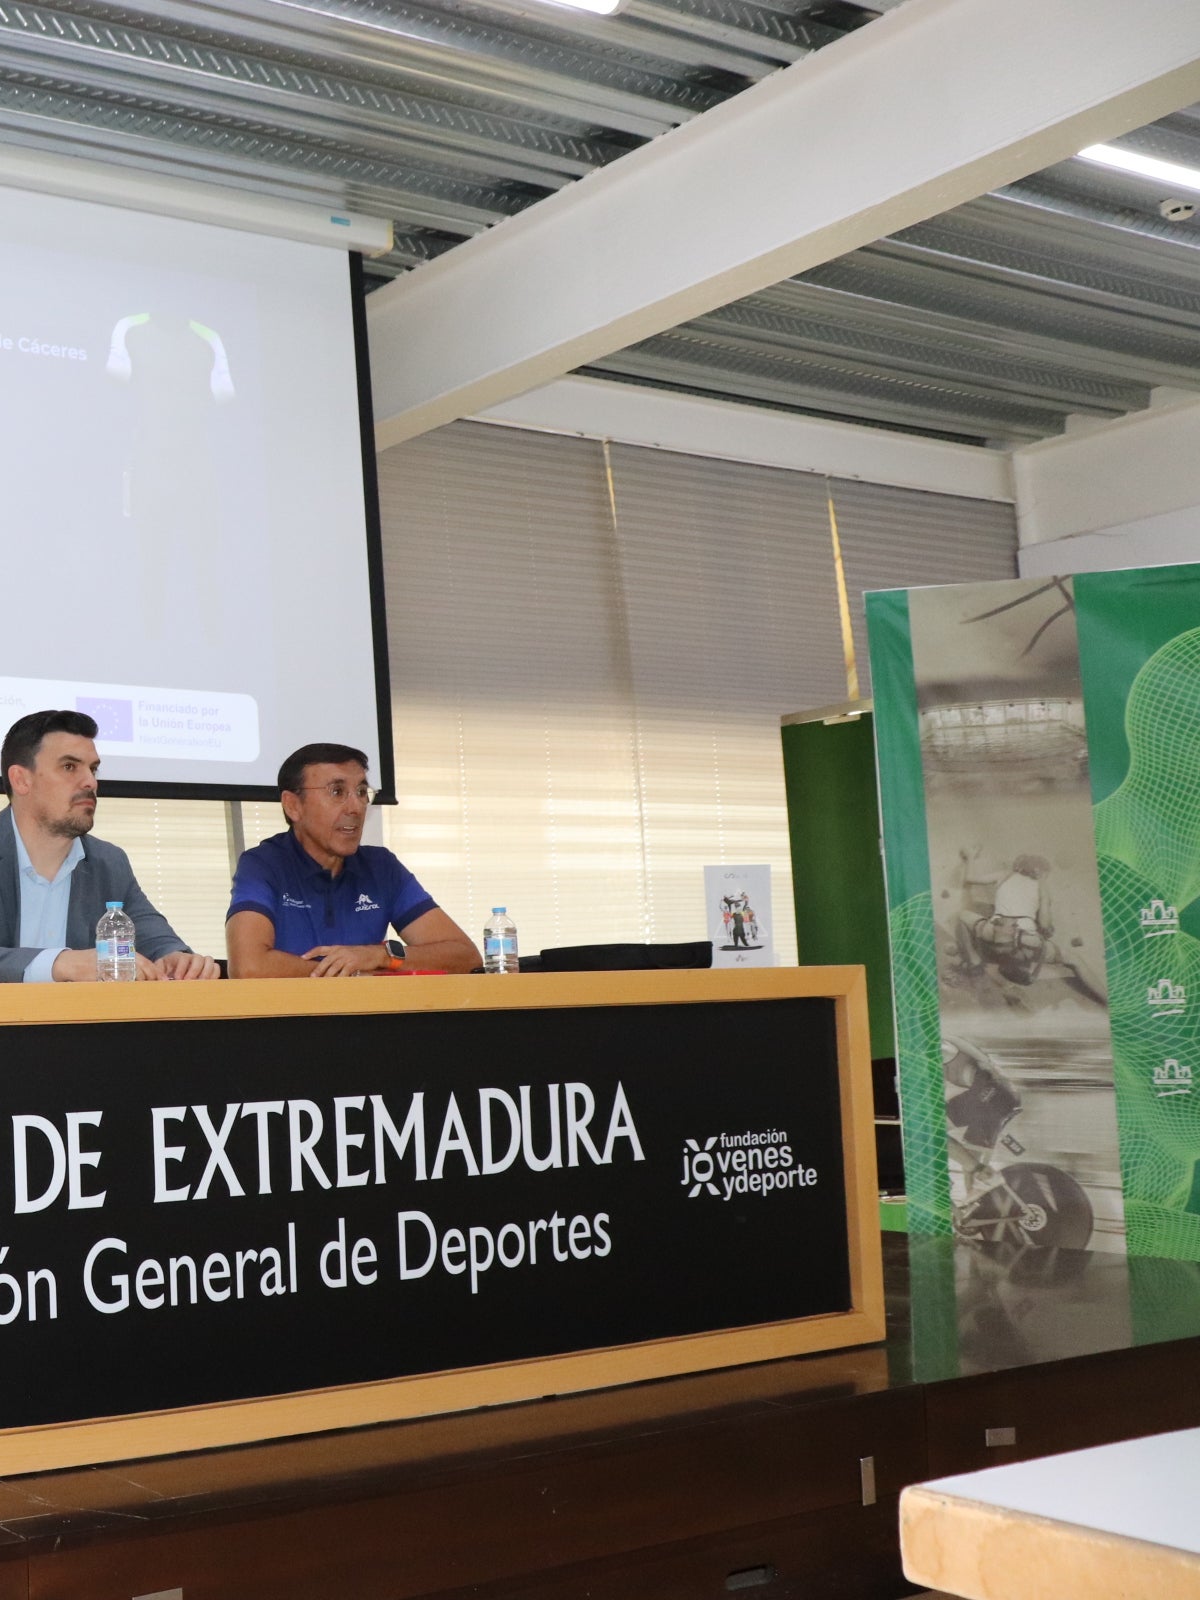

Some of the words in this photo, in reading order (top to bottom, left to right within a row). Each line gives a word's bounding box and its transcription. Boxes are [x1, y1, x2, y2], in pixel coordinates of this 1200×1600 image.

[18, 337, 88, 361] Cáceres
[12, 1110, 107, 1214] DE
[151, 1080, 646, 1204] EXTREMADURA
[720, 1128, 787, 1149] fundación
[83, 1222, 297, 1315] General
[319, 1218, 378, 1289] de
[397, 1210, 612, 1294] Deportes
